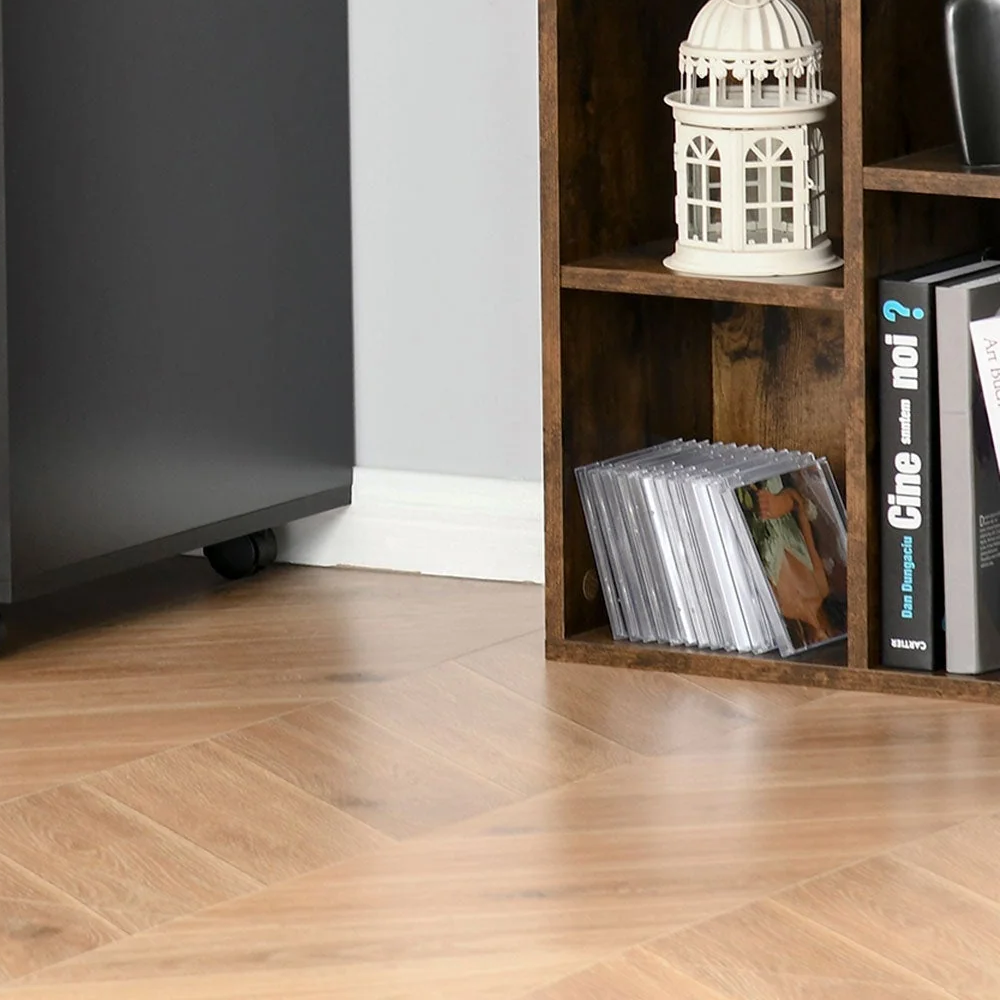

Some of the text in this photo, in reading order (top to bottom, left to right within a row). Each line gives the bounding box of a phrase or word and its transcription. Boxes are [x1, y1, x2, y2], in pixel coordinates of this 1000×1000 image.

[884, 333, 919, 390] noi
[983, 337, 1000, 407] Art Buc
[899, 398, 912, 446] suntem
[887, 451, 922, 530] Cine
[900, 535, 916, 619] Dan Dungaciu
[890, 638, 928, 651] CARTIER
